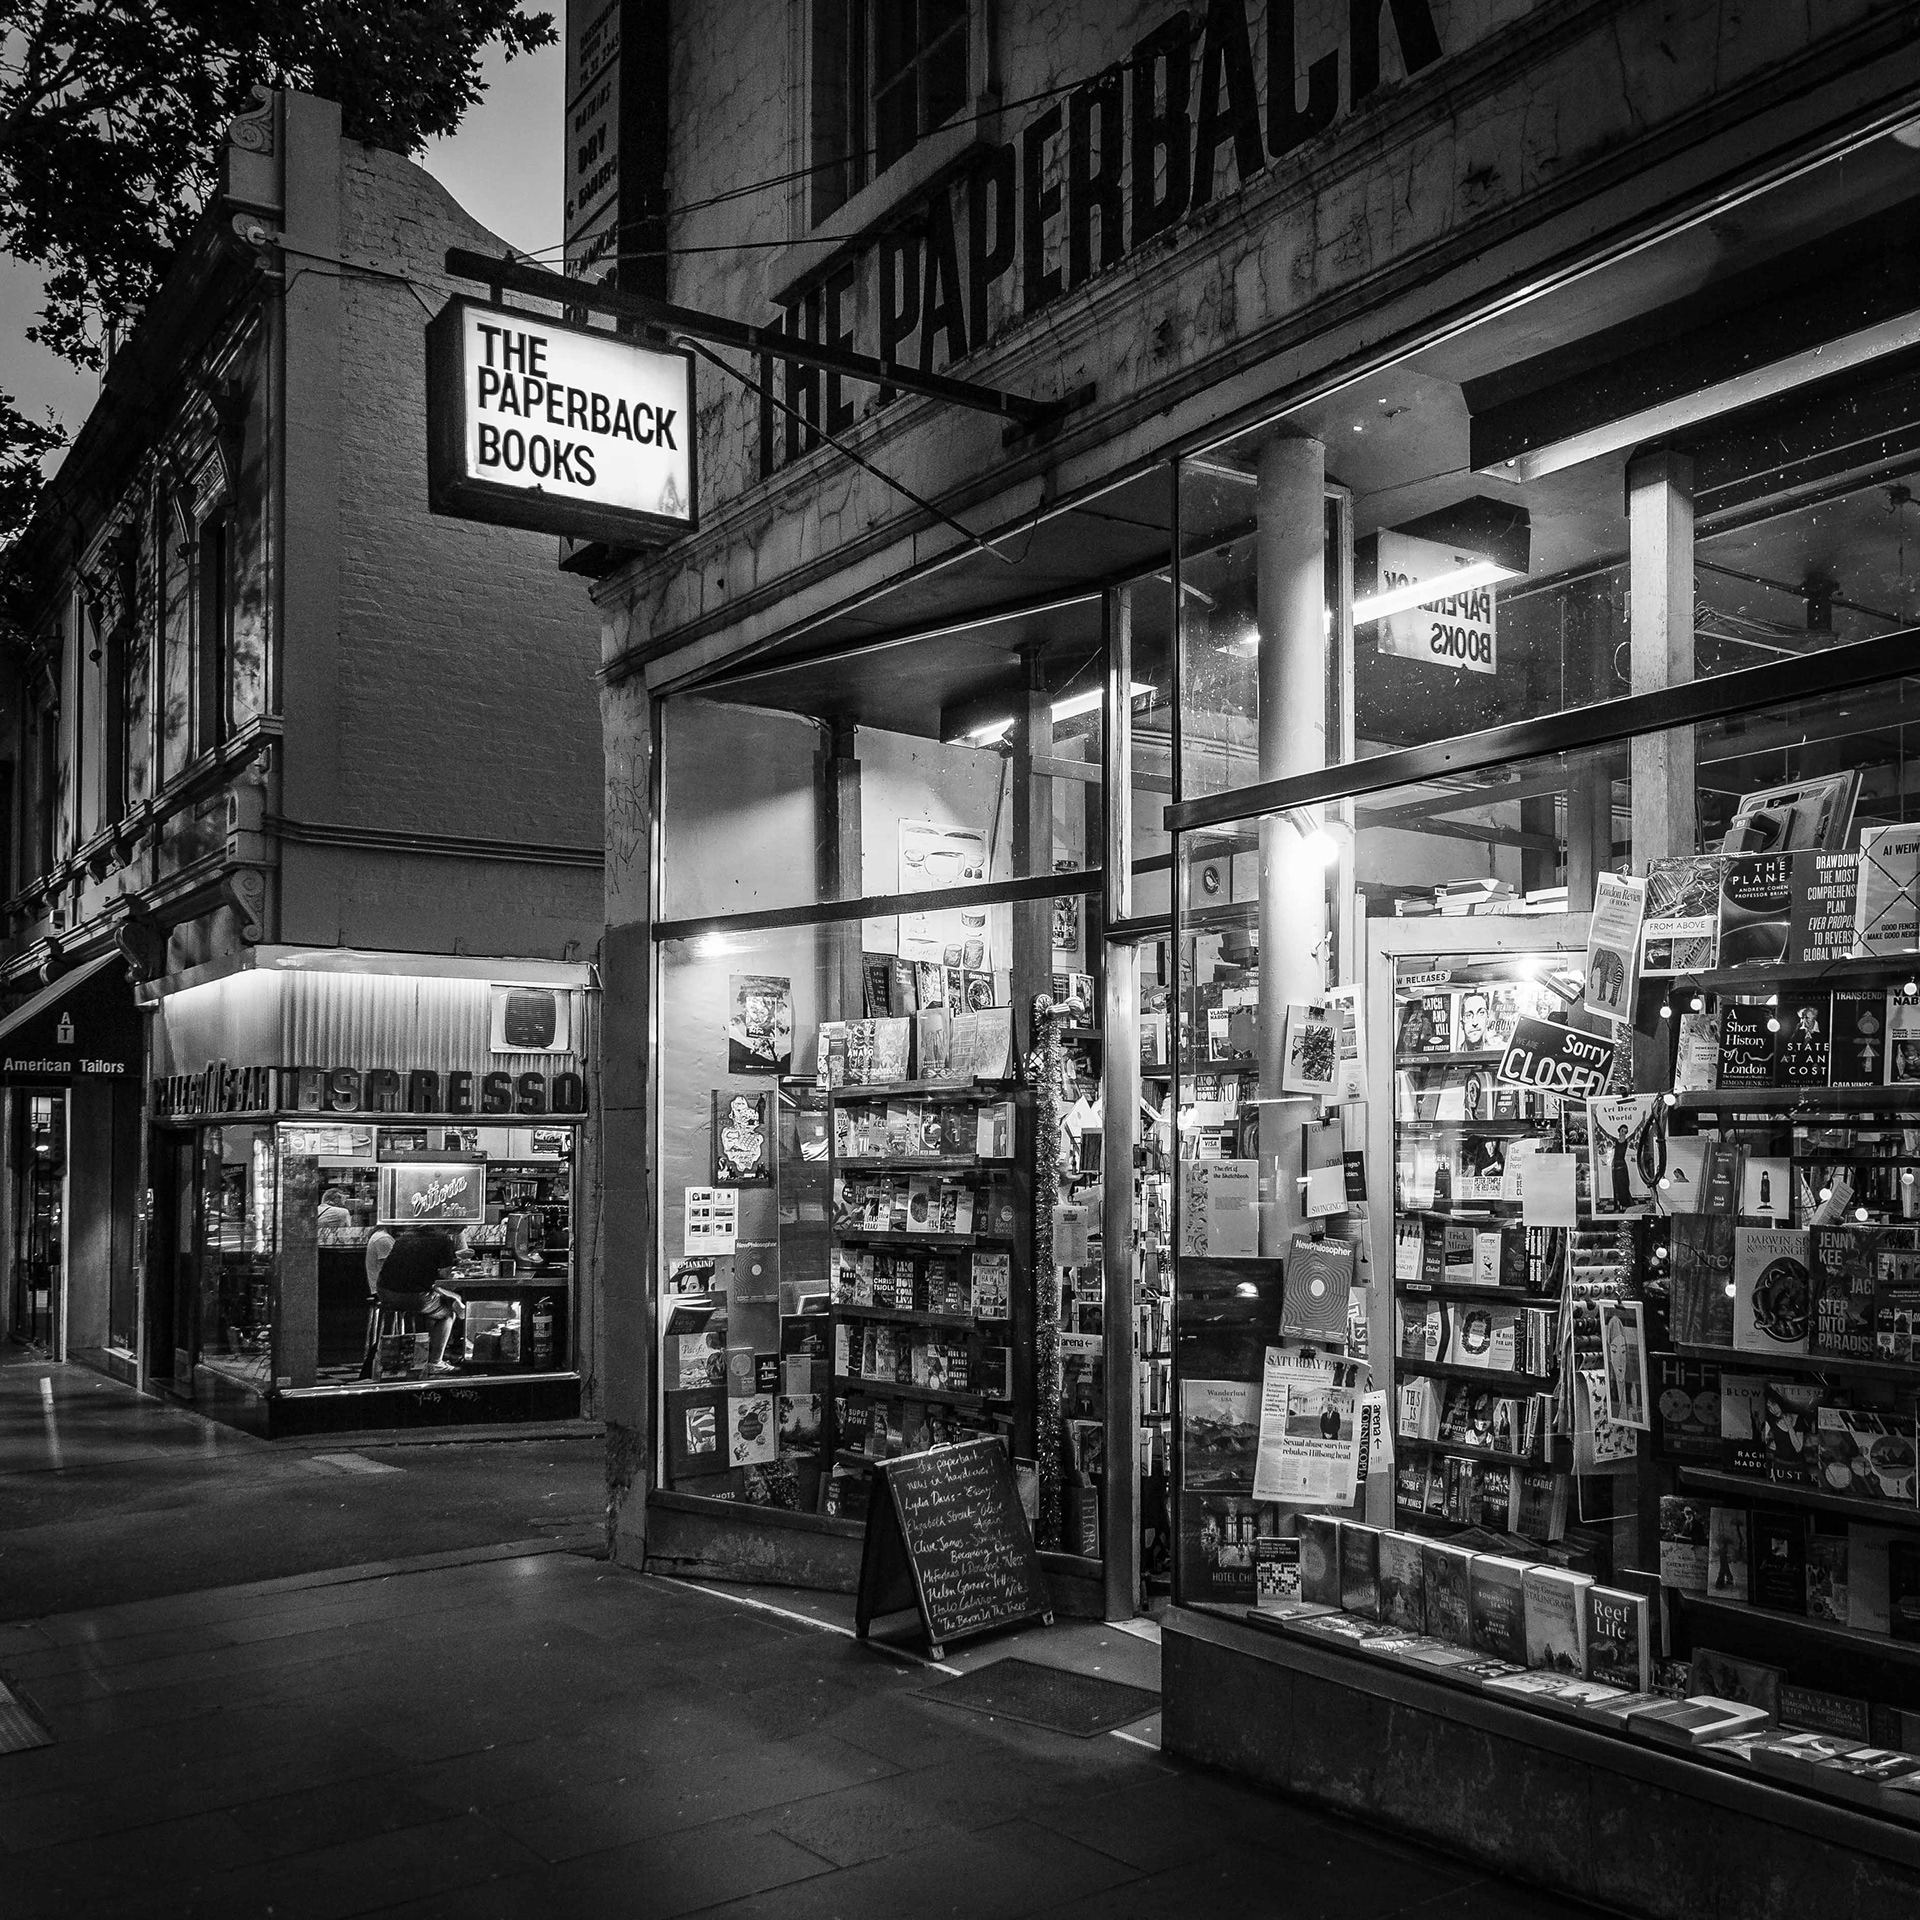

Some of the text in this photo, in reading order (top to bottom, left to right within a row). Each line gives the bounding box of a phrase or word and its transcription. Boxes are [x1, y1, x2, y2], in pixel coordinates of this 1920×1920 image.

[578, 123, 606, 174] DRY
[477, 322, 548, 379] THE
[757, 263, 855, 480] THE
[478, 366, 678, 451] PAPERBACK
[478, 421, 596, 487] BOOKS
[1882, 845, 1894, 857] AI
[1754, 862, 1787, 872] THE
[1815, 853, 1860, 870] DRAWDOWN
[1819, 869, 1856, 883] THE MOST
[1600, 885, 1621, 899] London
[1769, 890, 1788, 898] BRIAN
[1616, 900, 1630, 908] BOOKS
[1826, 900, 1846, 914] PLAN
[1649, 920, 1705, 932] FROM ABOVE
[1807, 916, 1828, 931] EVER
[1881, 922, 1920, 932] GOOD FENCES
[1813, 933, 1824, 945] TO
[1866, 932, 1883, 941] MAKE
[1884, 931, 1899, 940] GOOD
[1803, 947, 1833, 961] GLOBAL
[1406, 972, 1446, 984] RELEASES
[1422, 997, 1443, 1010] CATCH
[61, 1011, 71, 1025] A
[1432, 1010, 1446, 1023] AND
[1726, 1008, 1738, 1020] A
[1435, 1023, 1449, 1036] KILL
[1726, 1021, 1758, 1033] Short
[60, 1028, 71, 1041] T
[1725, 1034, 1766, 1049] History
[1562, 1033, 1611, 1068] Sorry
[1787, 1042, 1830, 1051] STATE
[1723, 1047, 1738, 1061] of
[1780, 1054, 1826, 1063] AT AN
[3, 1057, 125, 1074] American Tailors
[1722, 1062, 1767, 1075] London
[1788, 1066, 1827, 1075] COST
[1504, 1048, 1605, 1099] CLOSED
[235, 1066, 270, 1112] BAR
[298, 1066, 582, 1114] ESPRESSO
[1602, 1105, 1638, 1114] Art Deco
[1609, 1113, 1632, 1122] World
[1213, 1165, 1238, 1173] The Art of
[1325, 1156, 1342, 1168] DOWN
[1222, 1172, 1249, 1180] Sketchbook
[1485, 1176, 1501, 1184] TEMPLE
[1311, 1201, 1342, 1214] SWINGING
[1448, 1232, 1467, 1240] Trick
[1480, 1237, 1496, 1245] Europe
[1818, 1232, 1856, 1250] JENNY
[1295, 1238, 1352, 1257] NewPhilosopher
[1447, 1241, 1473, 1250] Mirror
[1746, 1244, 1754, 1253] &
[1818, 1249, 1843, 1266] KEE
[1818, 1298, 1848, 1315] STEP
[1818, 1315, 1846, 1333] INTO
[1061, 1338, 1083, 1347] arena
[1267, 1354, 1322, 1370] SATURDAY
[1207, 1389, 1247, 1397] Wanderlust
[1405, 1389, 1421, 1406] THIS
[1726, 1387, 1762, 1398] BLOW
[1372, 1404, 1382, 1436] arena
[1409, 1406, 1417, 1421] IS
[1283, 1438, 1351, 1450] Sexual abuse survivor
[1357, 1405, 1372, 1481] CORNUCOPIA
[1282, 1447, 1351, 1460] rebukes Hillsong head
[1737, 1449, 1766, 1459] RACH
[1524, 1476, 1532, 1485] LE
[1769, 1467, 1803, 1482] JUST
[905, 1498, 930, 1517] Lydia
[1407, 1496, 1422, 1509] JONES
[913, 1540, 938, 1555] Clive
[950, 1548, 992, 1564] Becoming
[1212, 1572, 1256, 1583] HOTEL CHE
[926, 1584, 956, 1603] Helen
[1478, 1591, 1513, 1606] BOUNDLESS
[1541, 1584, 1573, 1600] Grossman
[1524, 1591, 1573, 1610] STALINGRAD
[931, 1602, 958, 1618] Italo
[958, 1604, 1005, 1626] Baron In The
[1593, 1598, 1631, 1624] Reef
[1488, 1620, 1505, 1629] DAVID
[1596, 1616, 1626, 1640] Life
